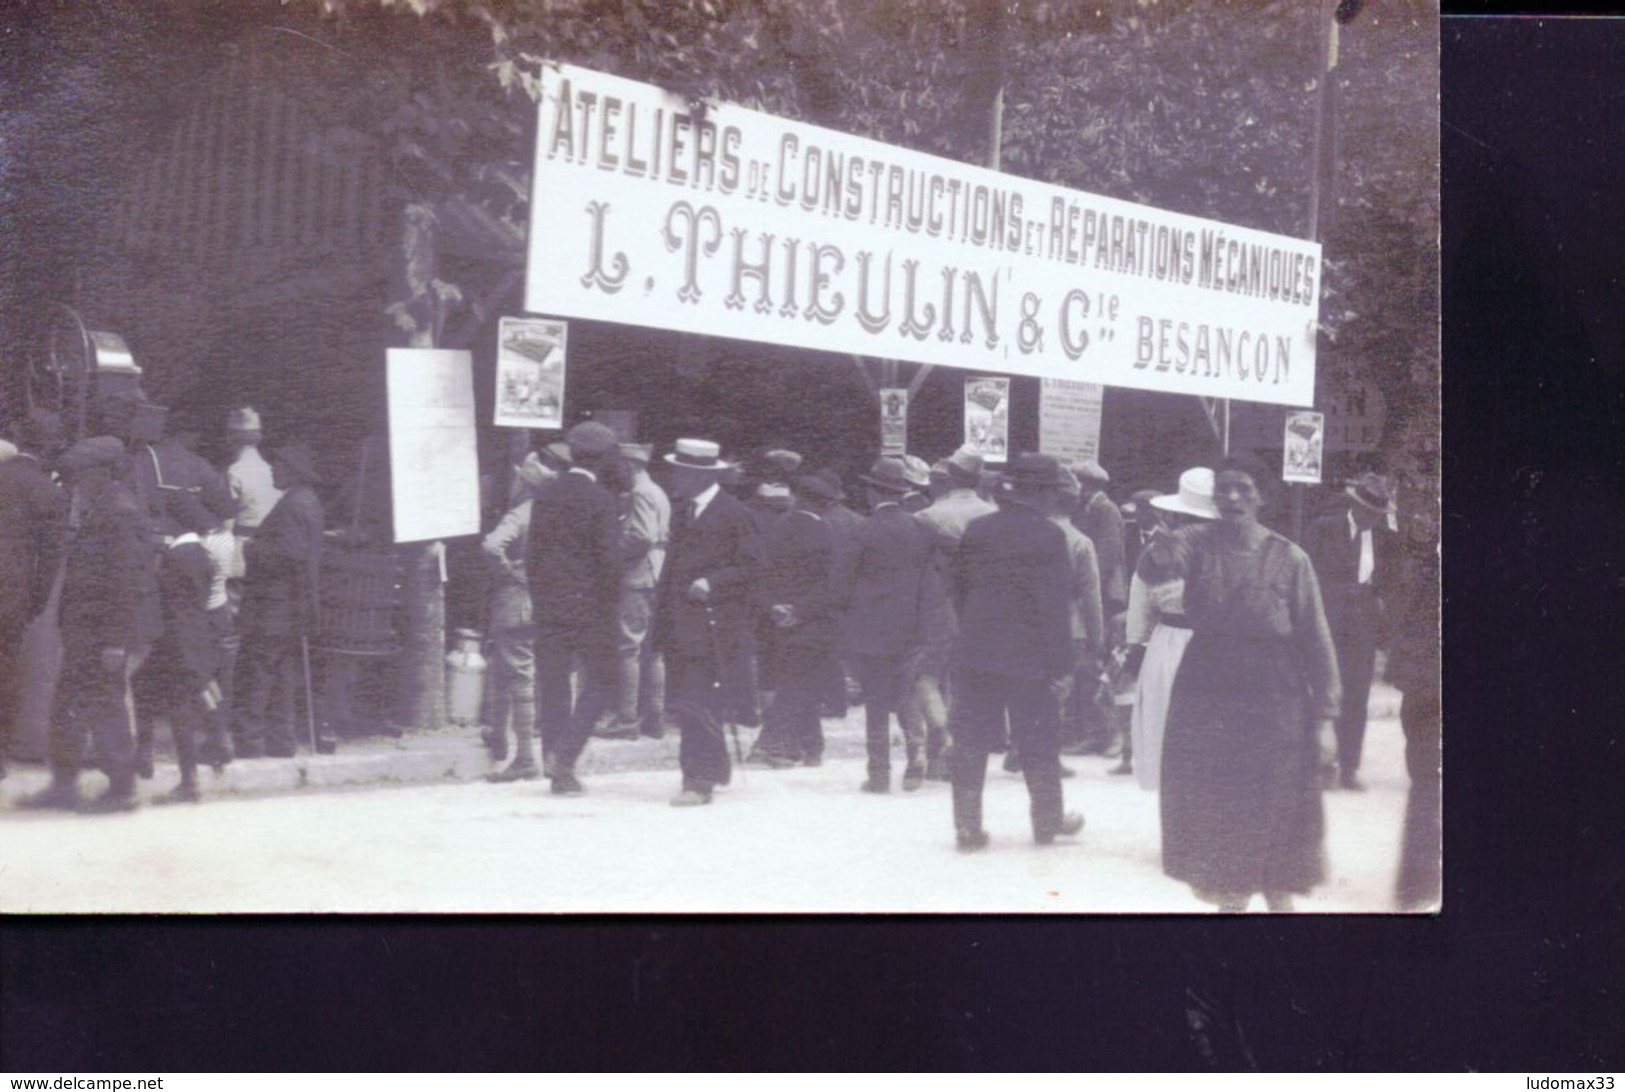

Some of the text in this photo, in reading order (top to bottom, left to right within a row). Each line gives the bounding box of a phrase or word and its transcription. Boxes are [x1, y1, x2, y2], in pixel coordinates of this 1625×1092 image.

[547, 78, 1316, 307] ATELIERS DE CONSTRUCTIONS ET RÉPARATIONS MÉCANIQUES
[661, 200, 1001, 351] THIEULIN
[1016, 291, 1044, 355] &
[1133, 315, 1292, 385] BESANÇON
